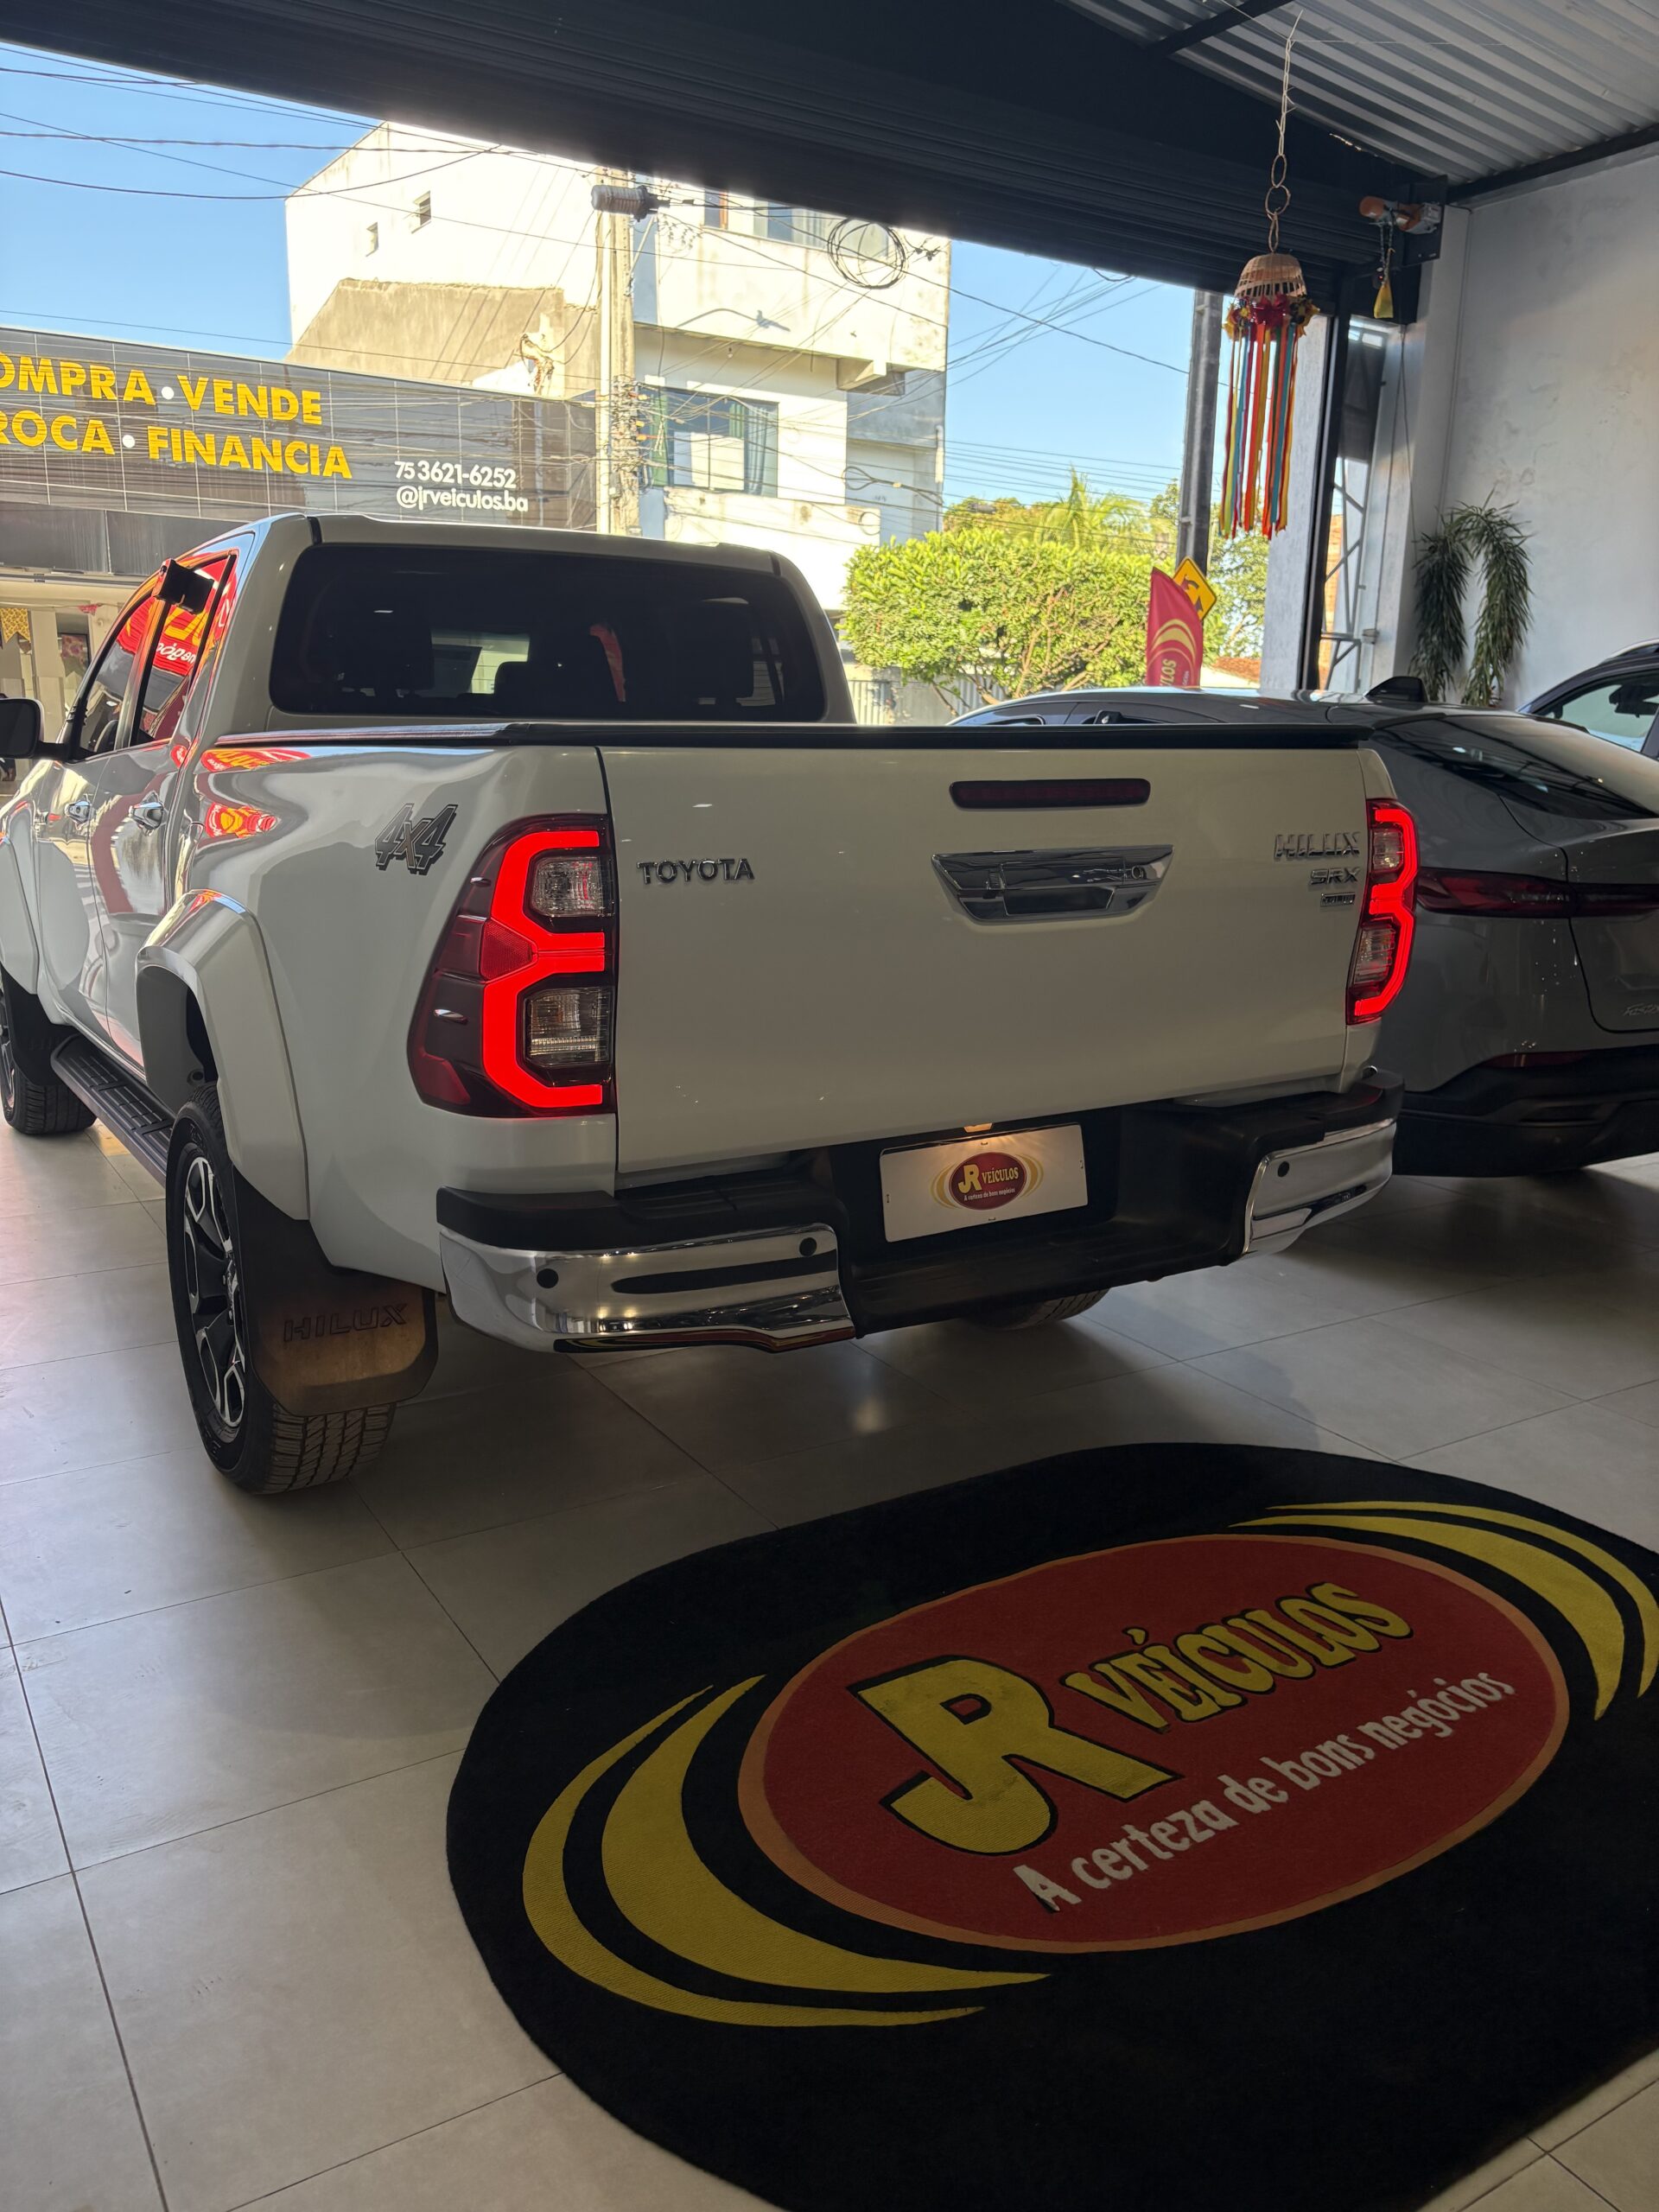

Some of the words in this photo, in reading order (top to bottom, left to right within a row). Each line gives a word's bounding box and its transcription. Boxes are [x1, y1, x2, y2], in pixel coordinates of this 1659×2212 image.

[177, 374, 323, 425] VENDE
[147, 425, 353, 480] FINANCIA
[394, 461, 416, 480] 75
[417, 460, 517, 489] 3621-6252
[396, 486, 529, 512] @jrveiculos.ba
[1274, 831, 1361, 861] HILUX
[637, 858, 755, 885] TOYOTA
[1309, 867, 1361, 887] SRX
[982, 1166, 1019, 1184] VEÍCULOS
[283, 1303, 408, 1343] HILUX
[1013, 1864, 1082, 1913] A
[1071, 1801, 1240, 1892] certeza
[1220, 1774, 1288, 1815] de
[1261, 1733, 1376, 1790] bons
[1357, 1672, 1516, 1751] negócios
